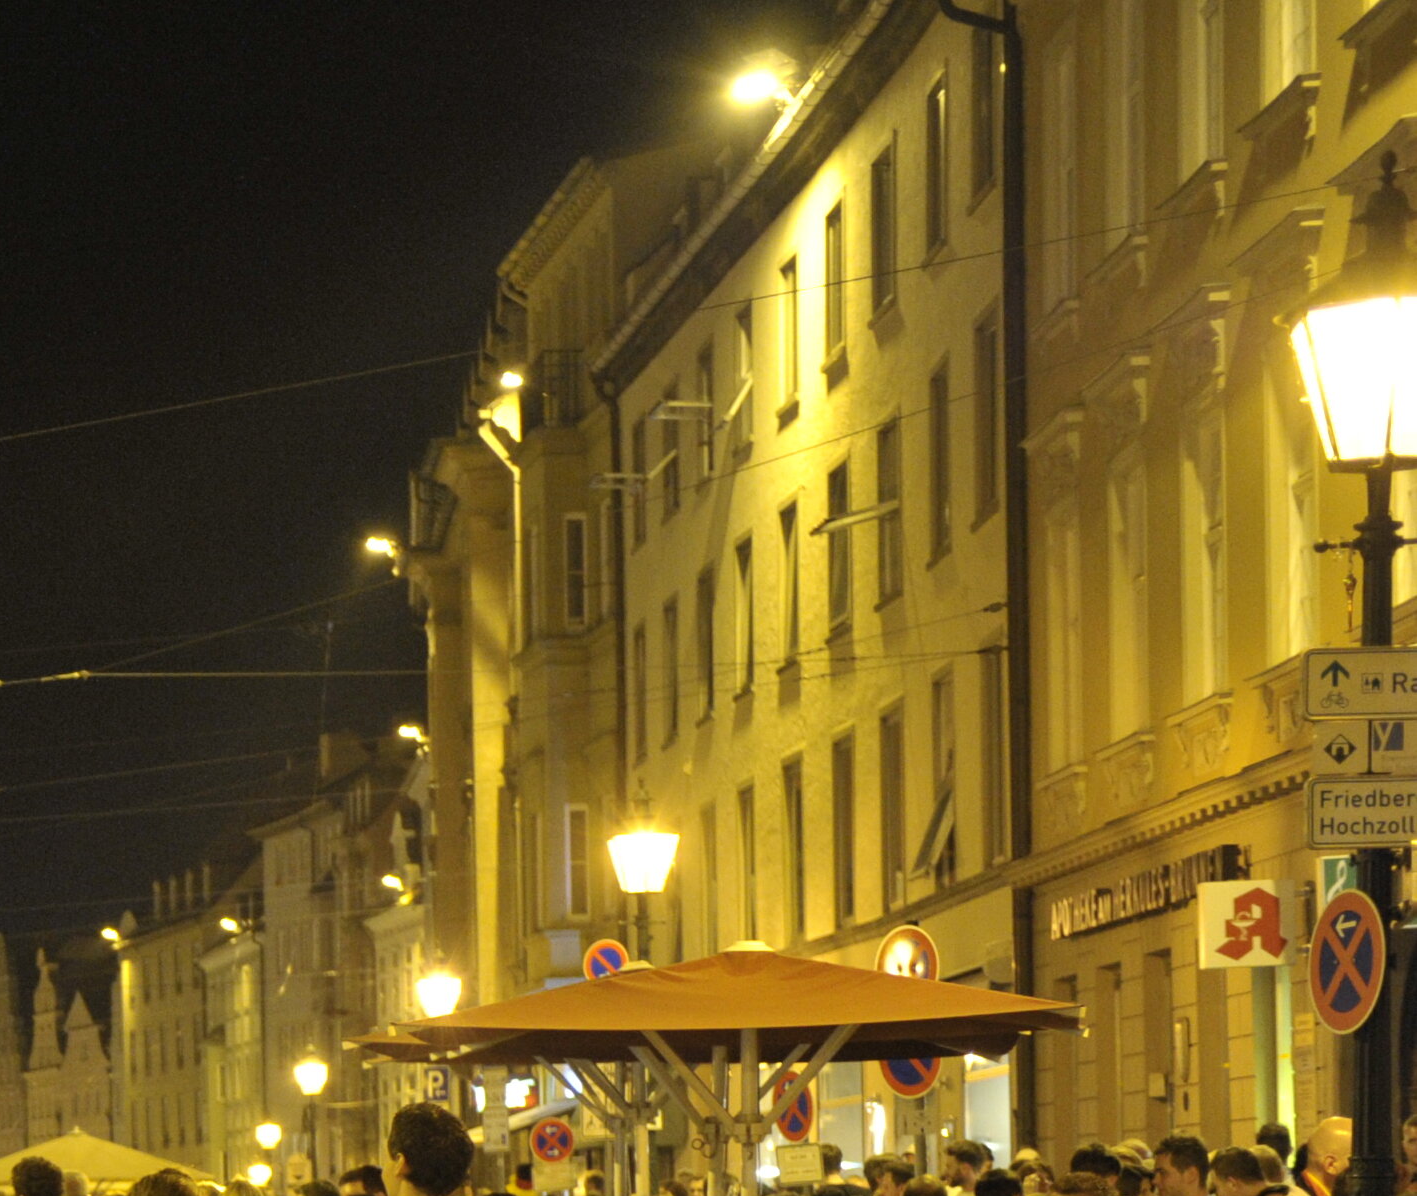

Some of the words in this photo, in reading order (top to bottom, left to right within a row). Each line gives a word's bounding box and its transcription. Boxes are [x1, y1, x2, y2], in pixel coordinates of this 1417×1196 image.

[1320, 817, 1415, 835] Hochzoll
[1050, 888, 1097, 940] APOTHEKE
[428, 1069, 444, 1098] P
